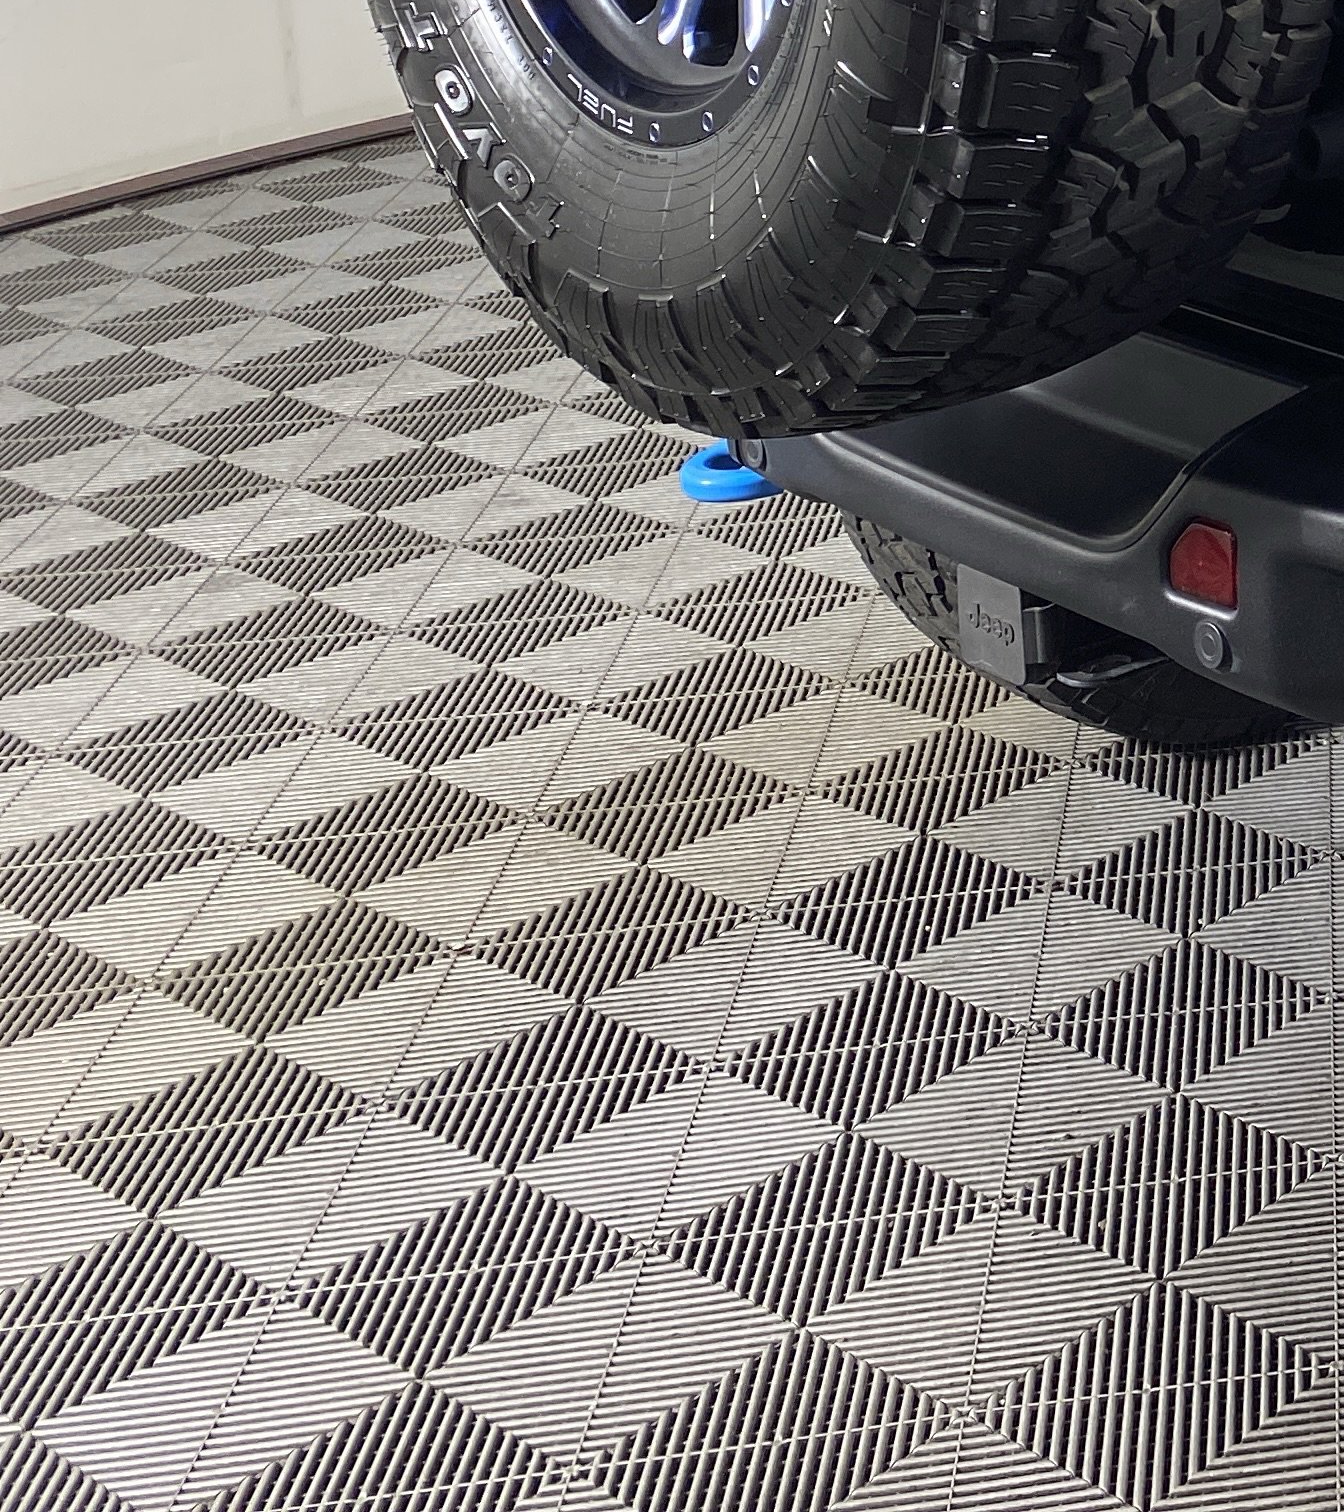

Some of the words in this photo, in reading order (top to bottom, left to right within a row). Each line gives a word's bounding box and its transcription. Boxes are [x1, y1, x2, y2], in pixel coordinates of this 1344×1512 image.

[566, 72, 635, 137] FUEL
[433, 64, 565, 242] TOYO
[967, 602, 1016, 647] Jeep
